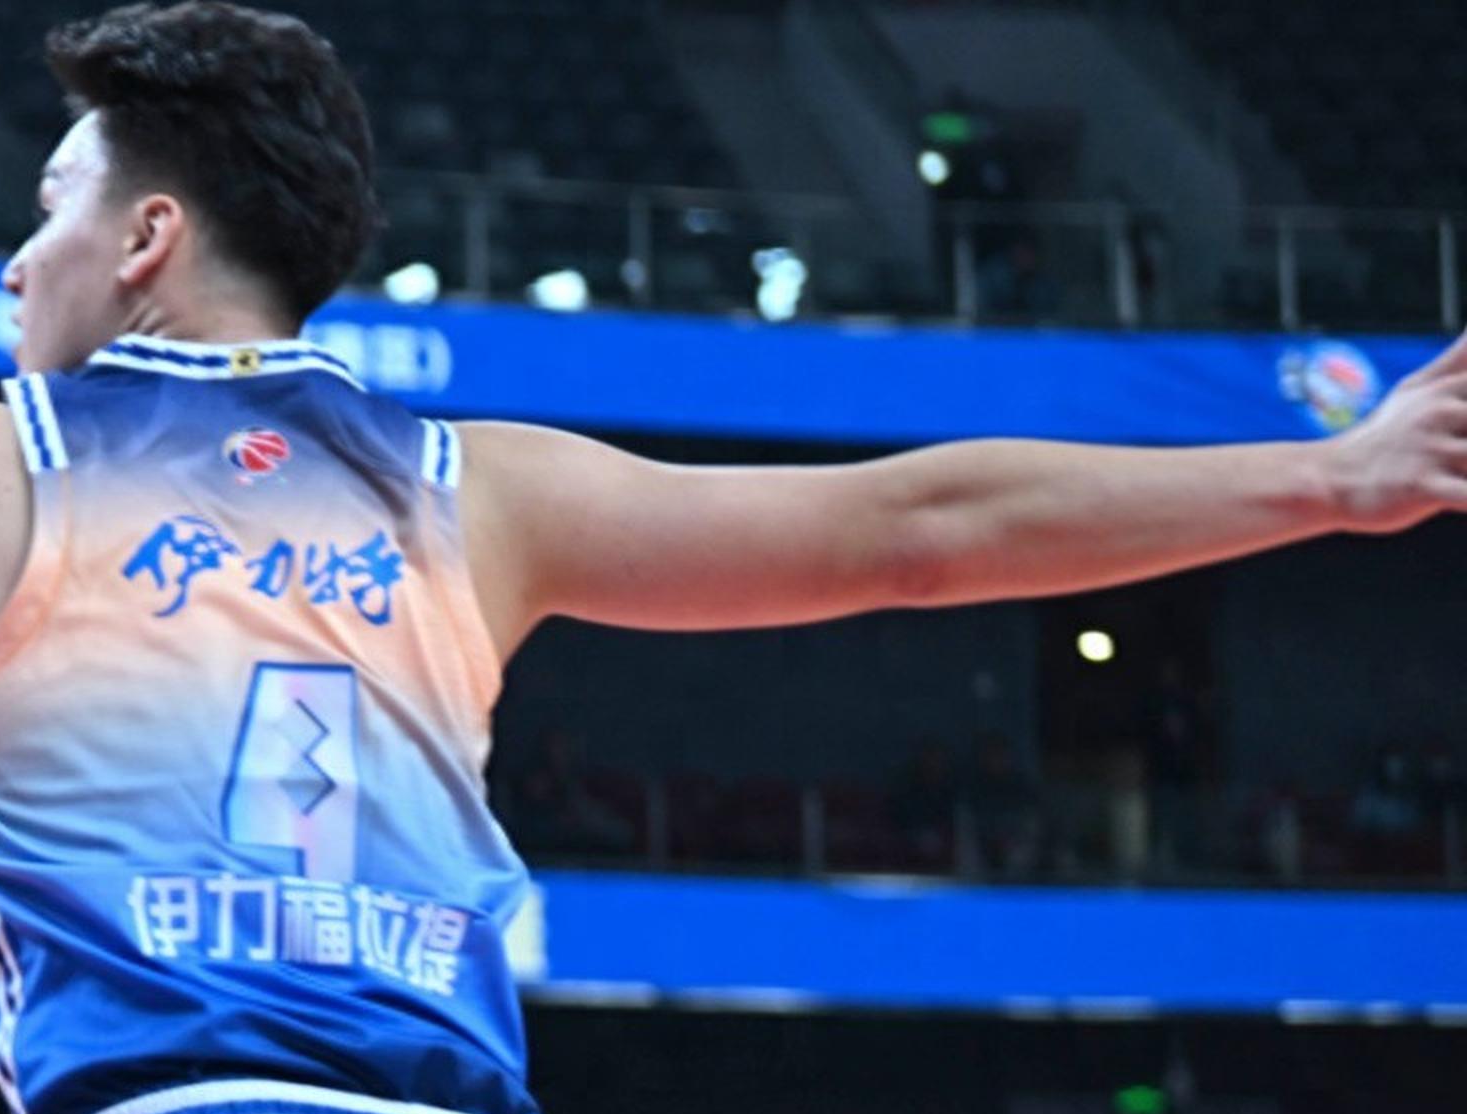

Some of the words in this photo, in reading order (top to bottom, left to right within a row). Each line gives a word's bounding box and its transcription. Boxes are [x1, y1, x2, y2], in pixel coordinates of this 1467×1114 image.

[127, 873, 471, 996] 伊力福拉提
